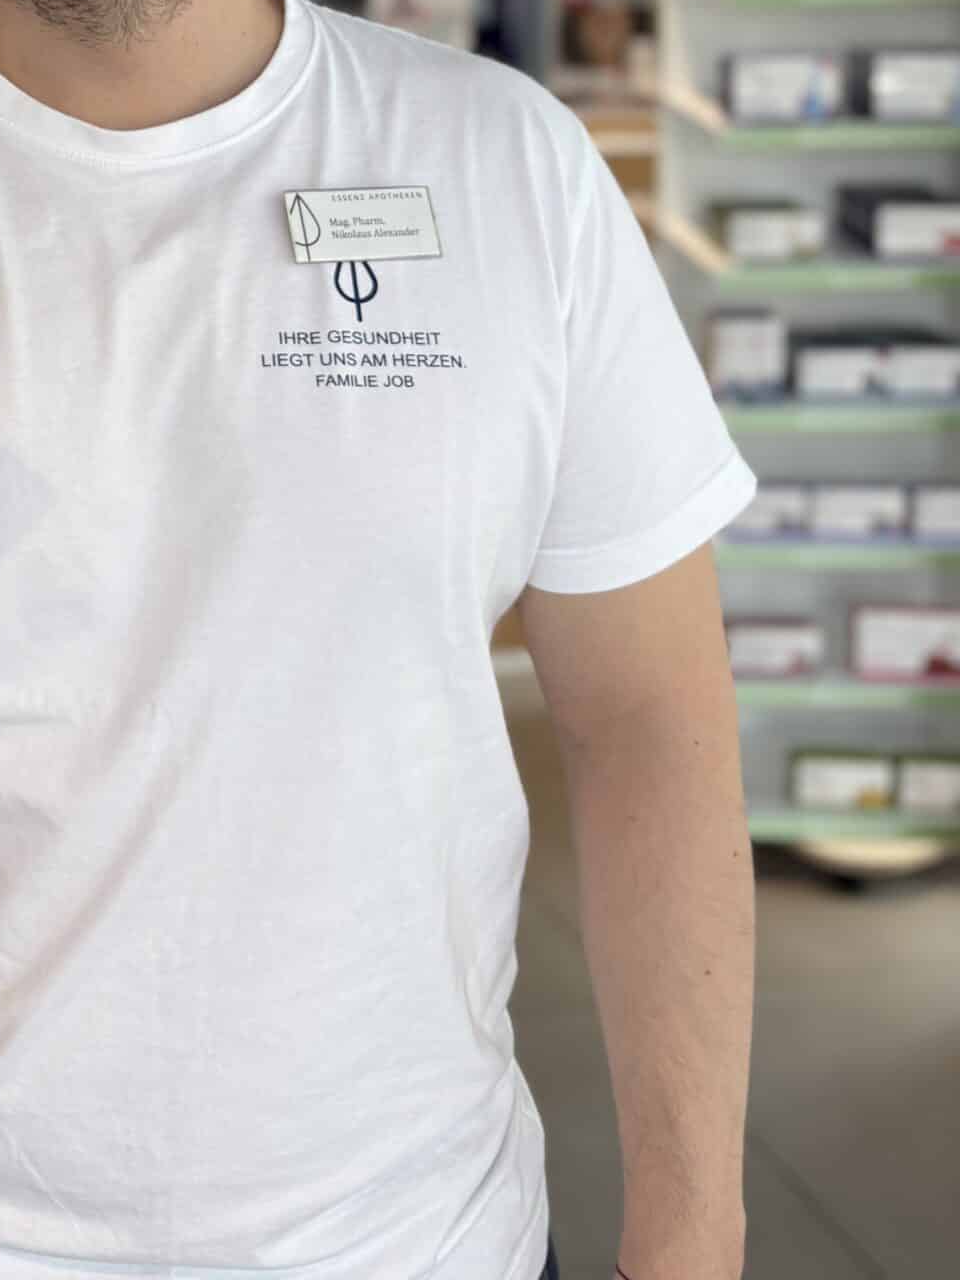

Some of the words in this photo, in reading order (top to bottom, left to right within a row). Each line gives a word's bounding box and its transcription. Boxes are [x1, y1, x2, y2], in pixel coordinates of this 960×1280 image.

[278, 330, 322, 345] IHRE
[327, 329, 440, 345] GESUNDHEIT
[260, 352, 314, 368] LIEGT
[319, 351, 358, 367] UNS
[359, 352, 388, 367] AM
[391, 353, 468, 369] HERZEN.
[315, 373, 380, 388] FAMILIE
[383, 374, 416, 388] JOB
